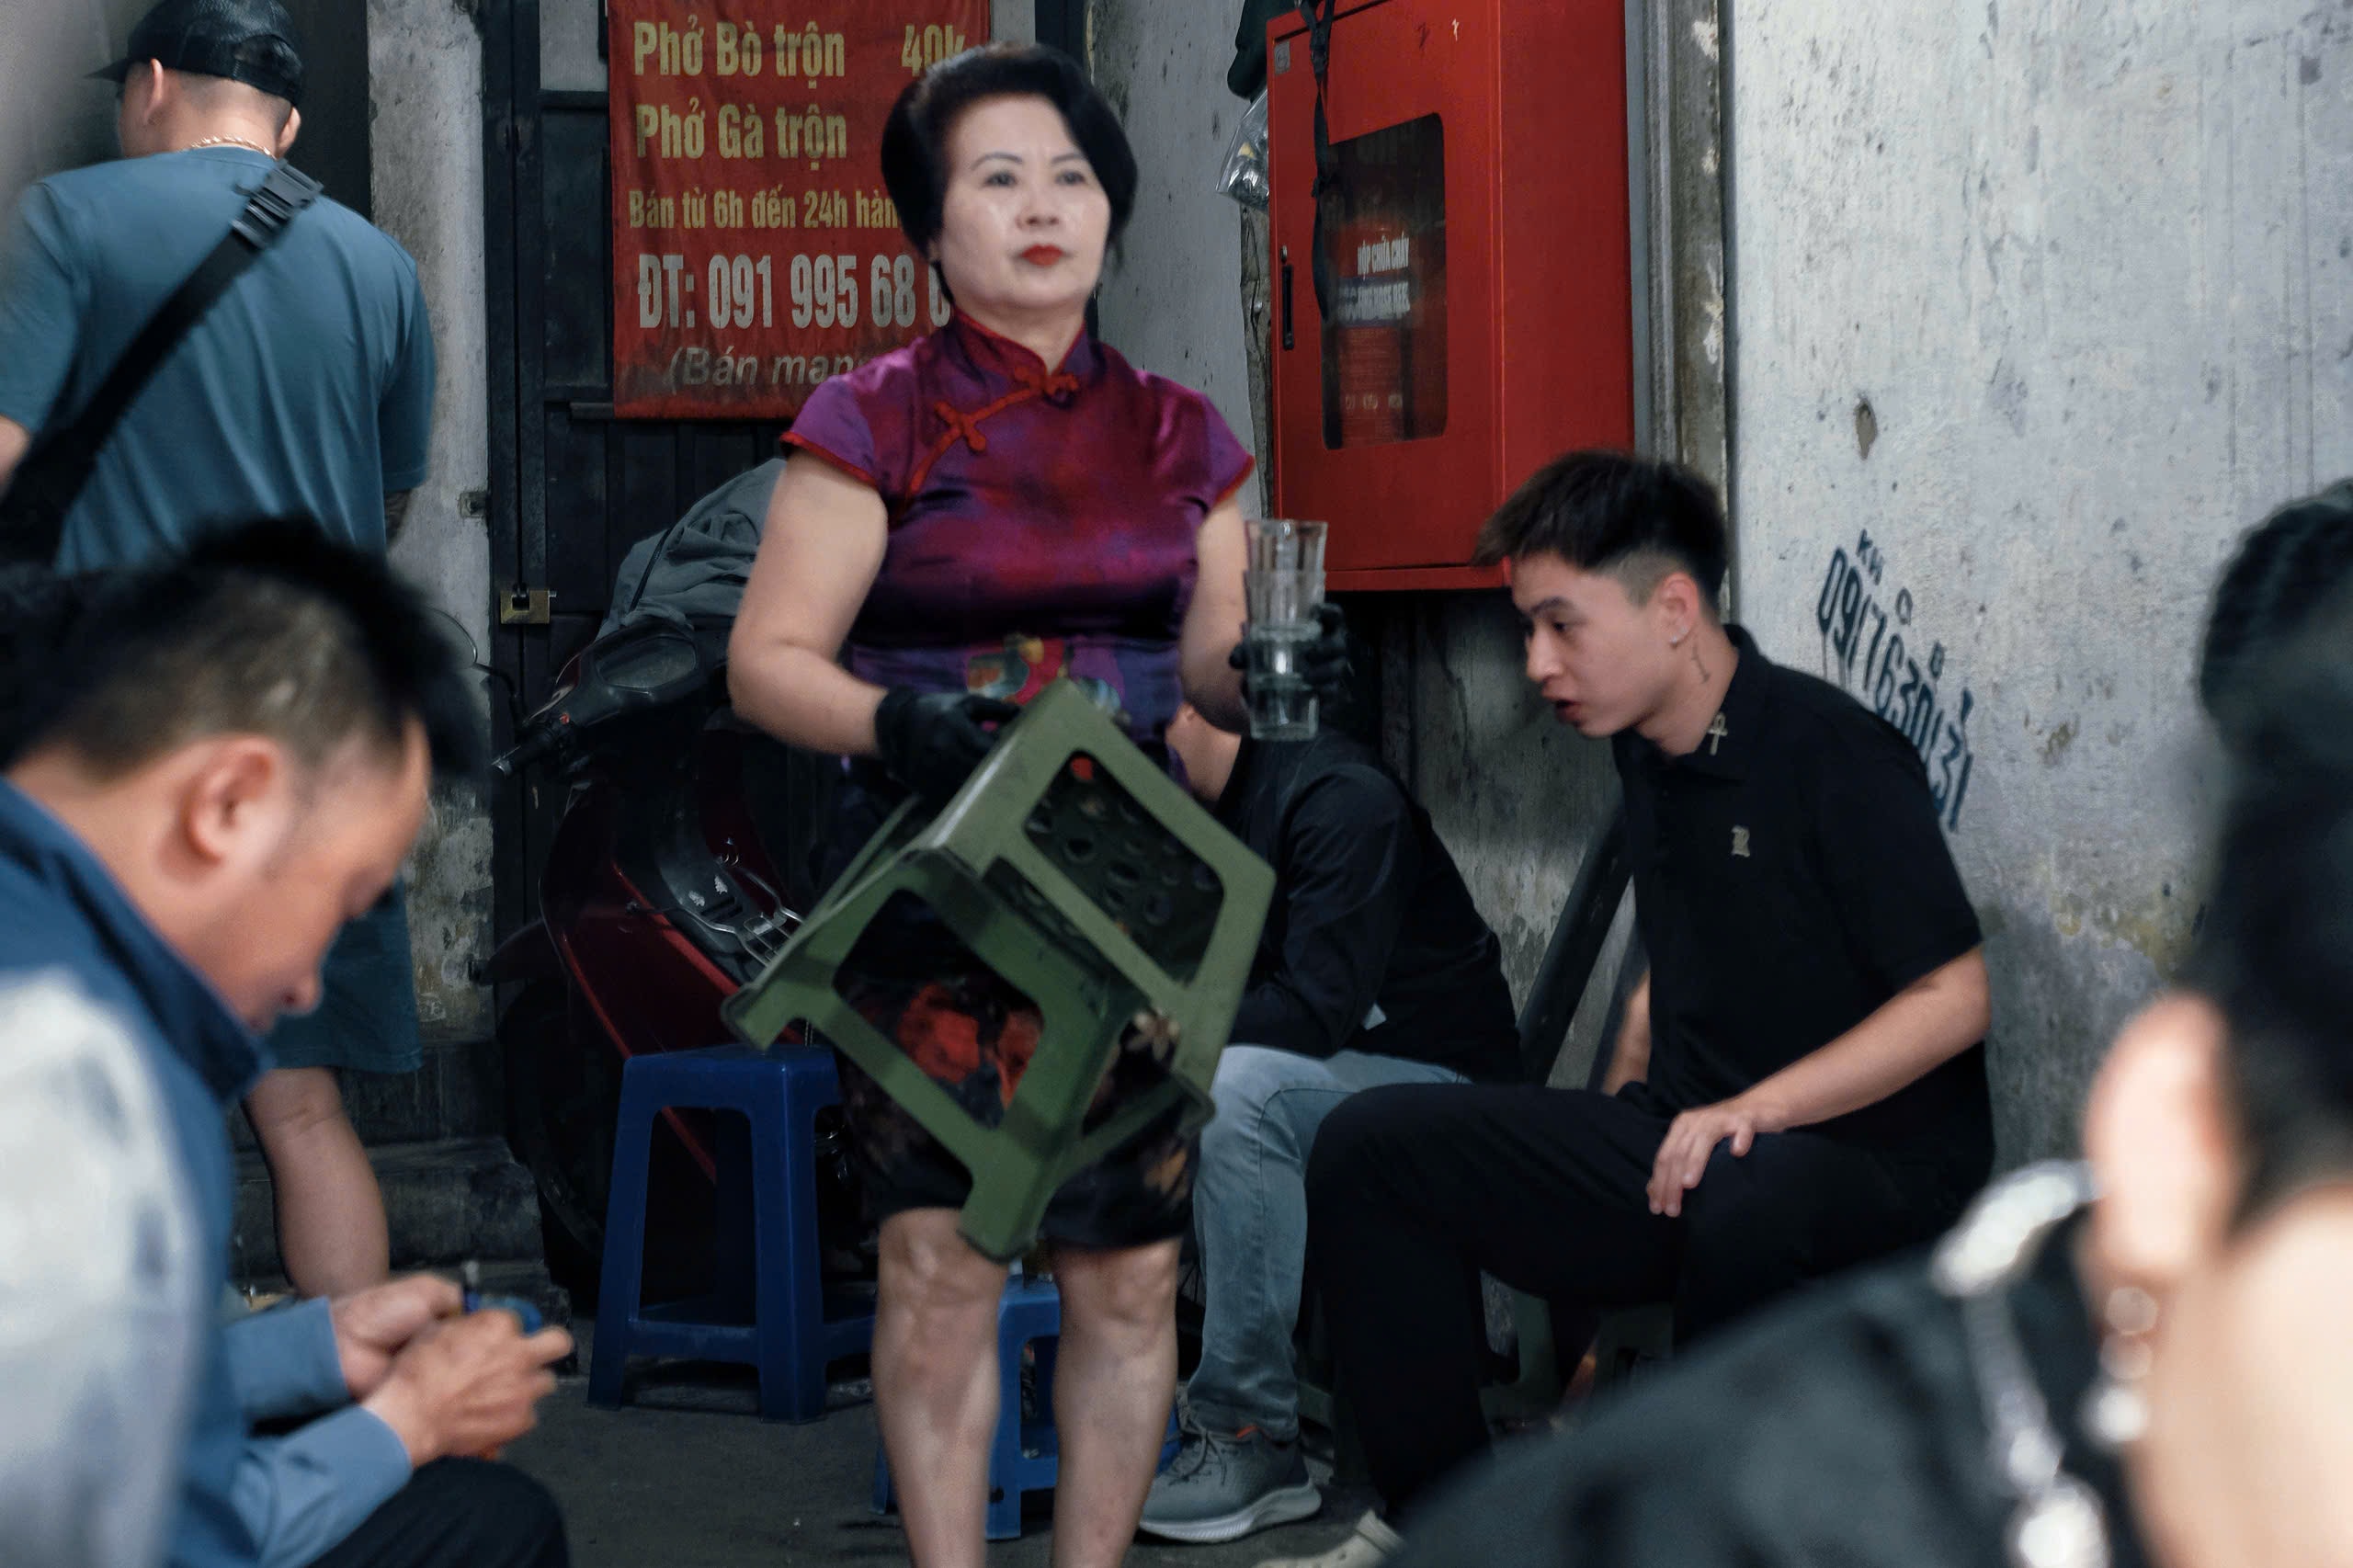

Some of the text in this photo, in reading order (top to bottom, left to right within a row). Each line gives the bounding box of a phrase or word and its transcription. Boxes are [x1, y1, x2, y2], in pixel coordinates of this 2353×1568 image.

[633, 14, 705, 76] Phở
[716, 20, 763, 76] Bò
[774, 20, 846, 89] trộn
[635, 97, 847, 171] Phở Gà trộn
[629, 184, 899, 229] Bán từ 6h đến 24h hàn
[638, 253, 696, 329] ĐT:
[708, 253, 773, 329] 091
[790, 253, 858, 329] 995
[870, 254, 917, 328] 68
[770, 352, 866, 384] man
